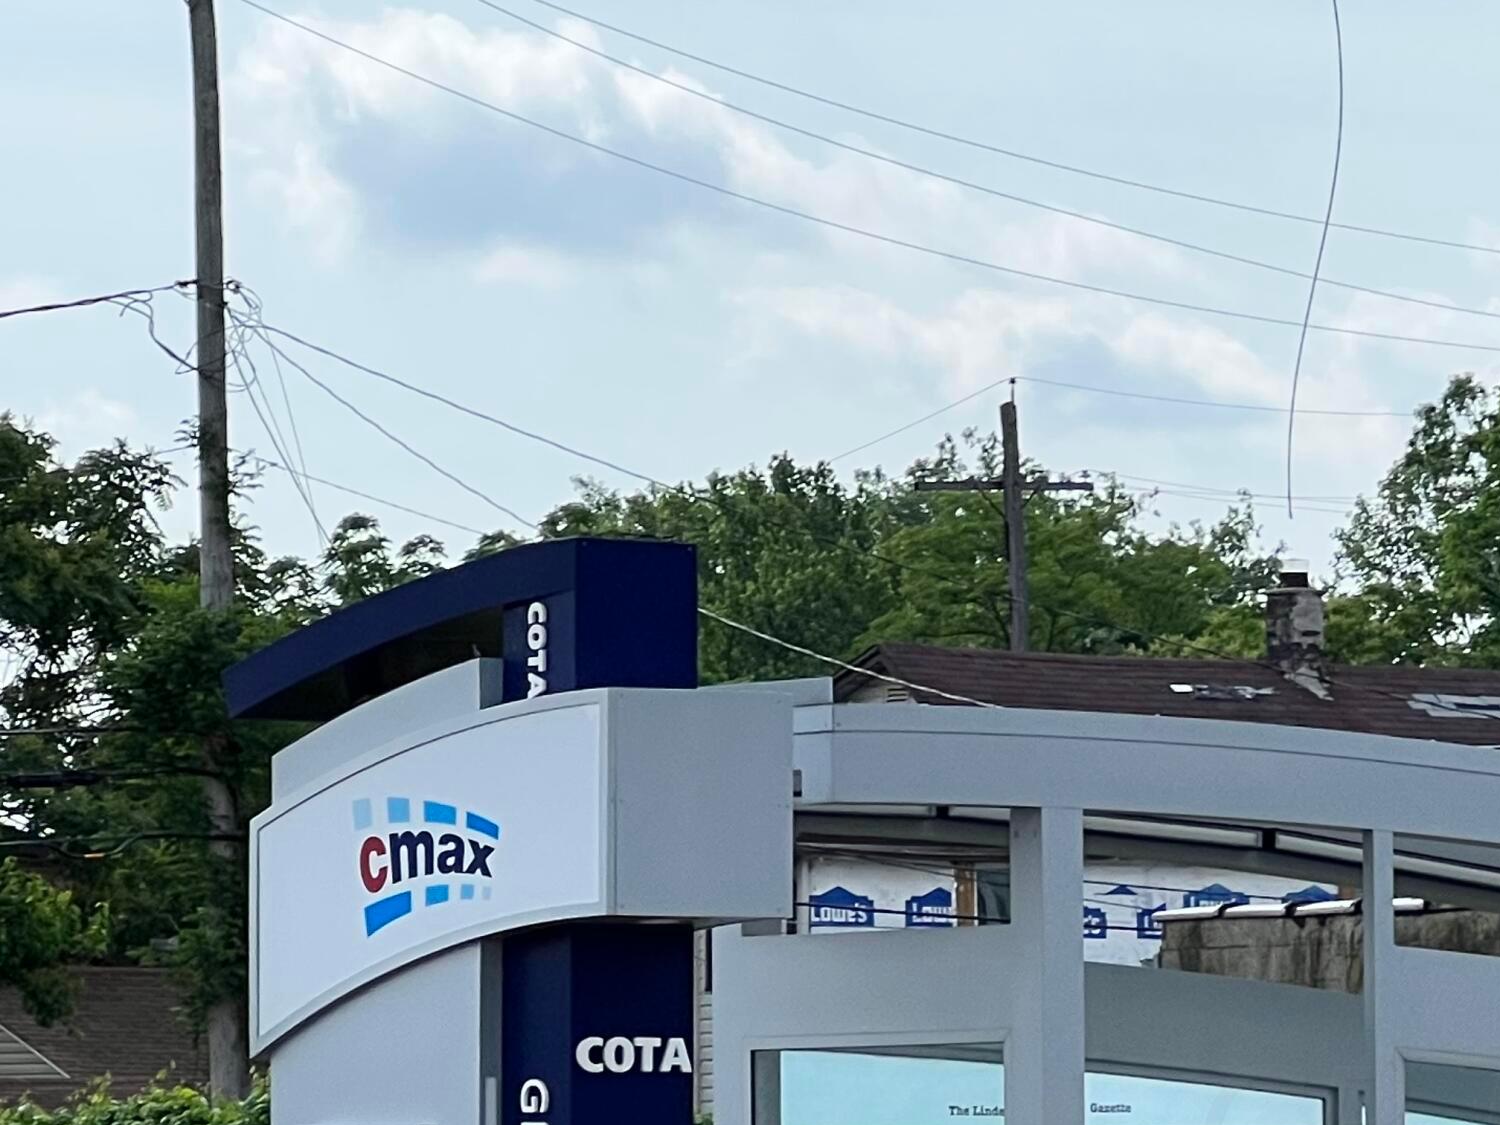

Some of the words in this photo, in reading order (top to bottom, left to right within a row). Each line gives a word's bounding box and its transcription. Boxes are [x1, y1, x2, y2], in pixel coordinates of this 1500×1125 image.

[525, 601, 549, 699] COTA
[359, 829, 497, 894] cmax
[575, 1036, 692, 1074] COTA
[948, 1105, 969, 1116] The
[972, 1105, 1006, 1117] Linde
[1089, 1102, 1132, 1114] Gazette
